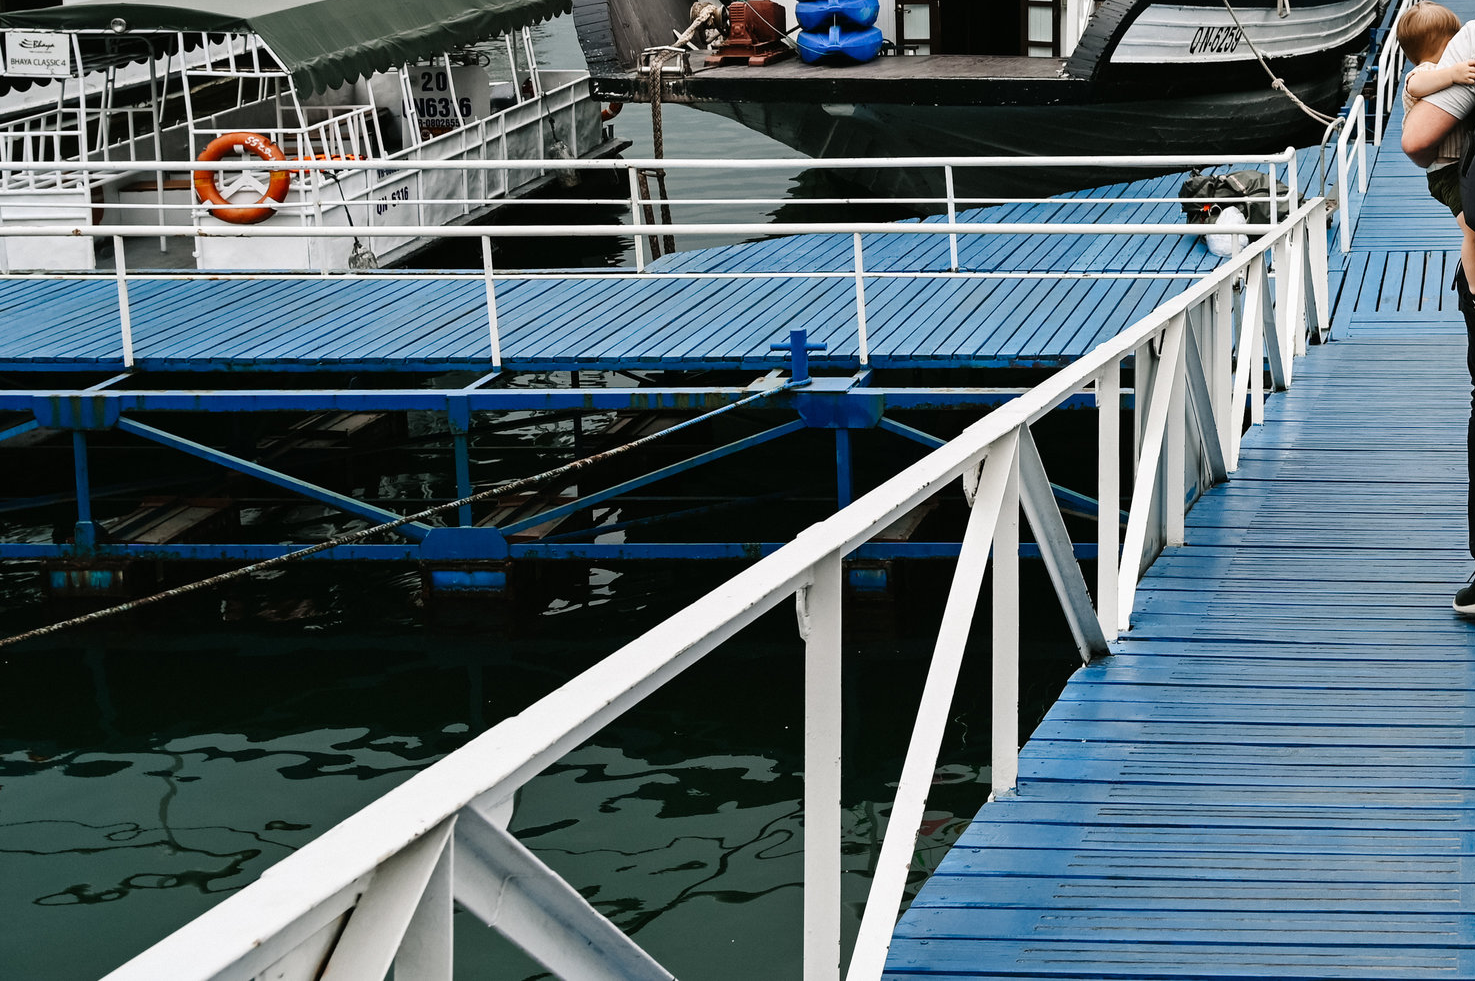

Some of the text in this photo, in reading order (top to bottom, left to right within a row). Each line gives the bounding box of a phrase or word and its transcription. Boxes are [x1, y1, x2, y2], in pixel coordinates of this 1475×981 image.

[33, 39, 55, 50] Bhaya
[10, 58, 67, 67] BHAYA CLASSIC 4
[420, 71, 448, 92] 20
